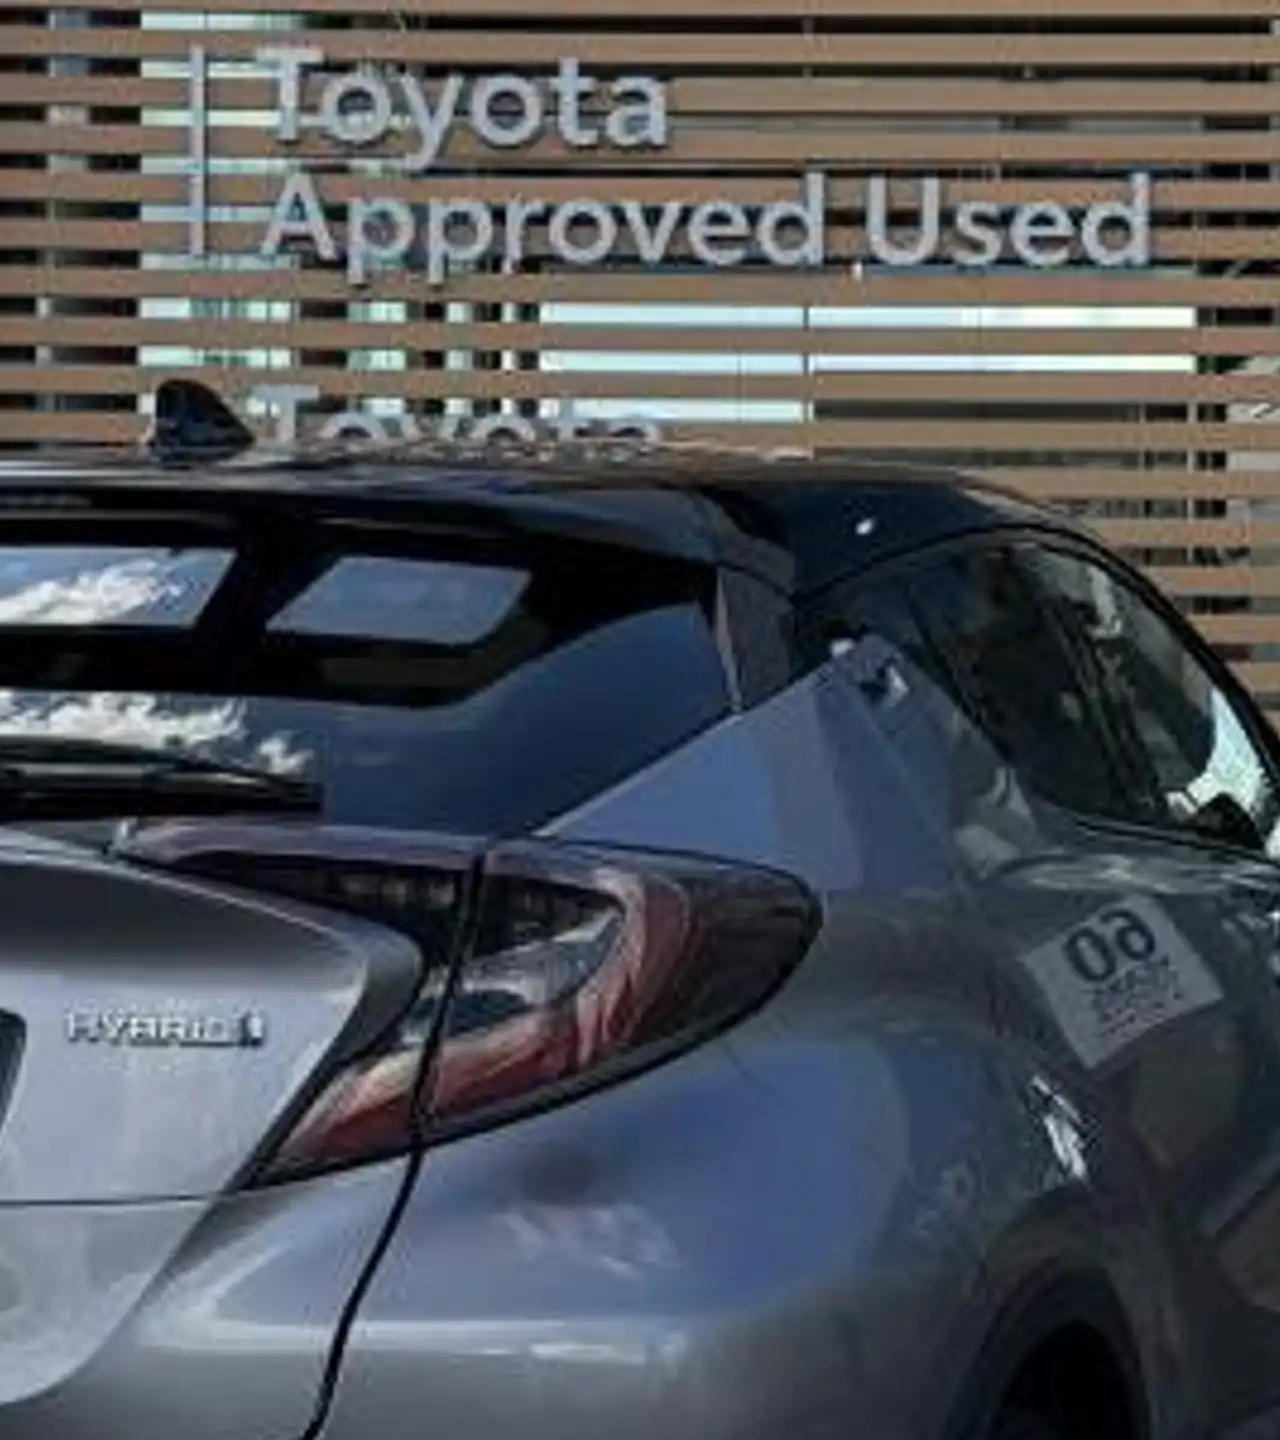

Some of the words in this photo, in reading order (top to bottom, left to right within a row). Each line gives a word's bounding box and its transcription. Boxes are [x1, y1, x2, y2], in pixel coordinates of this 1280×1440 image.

[257, 46, 669, 170] Toyota
[260, 171, 825, 285] Approved
[866, 171, 1151, 267] Used
